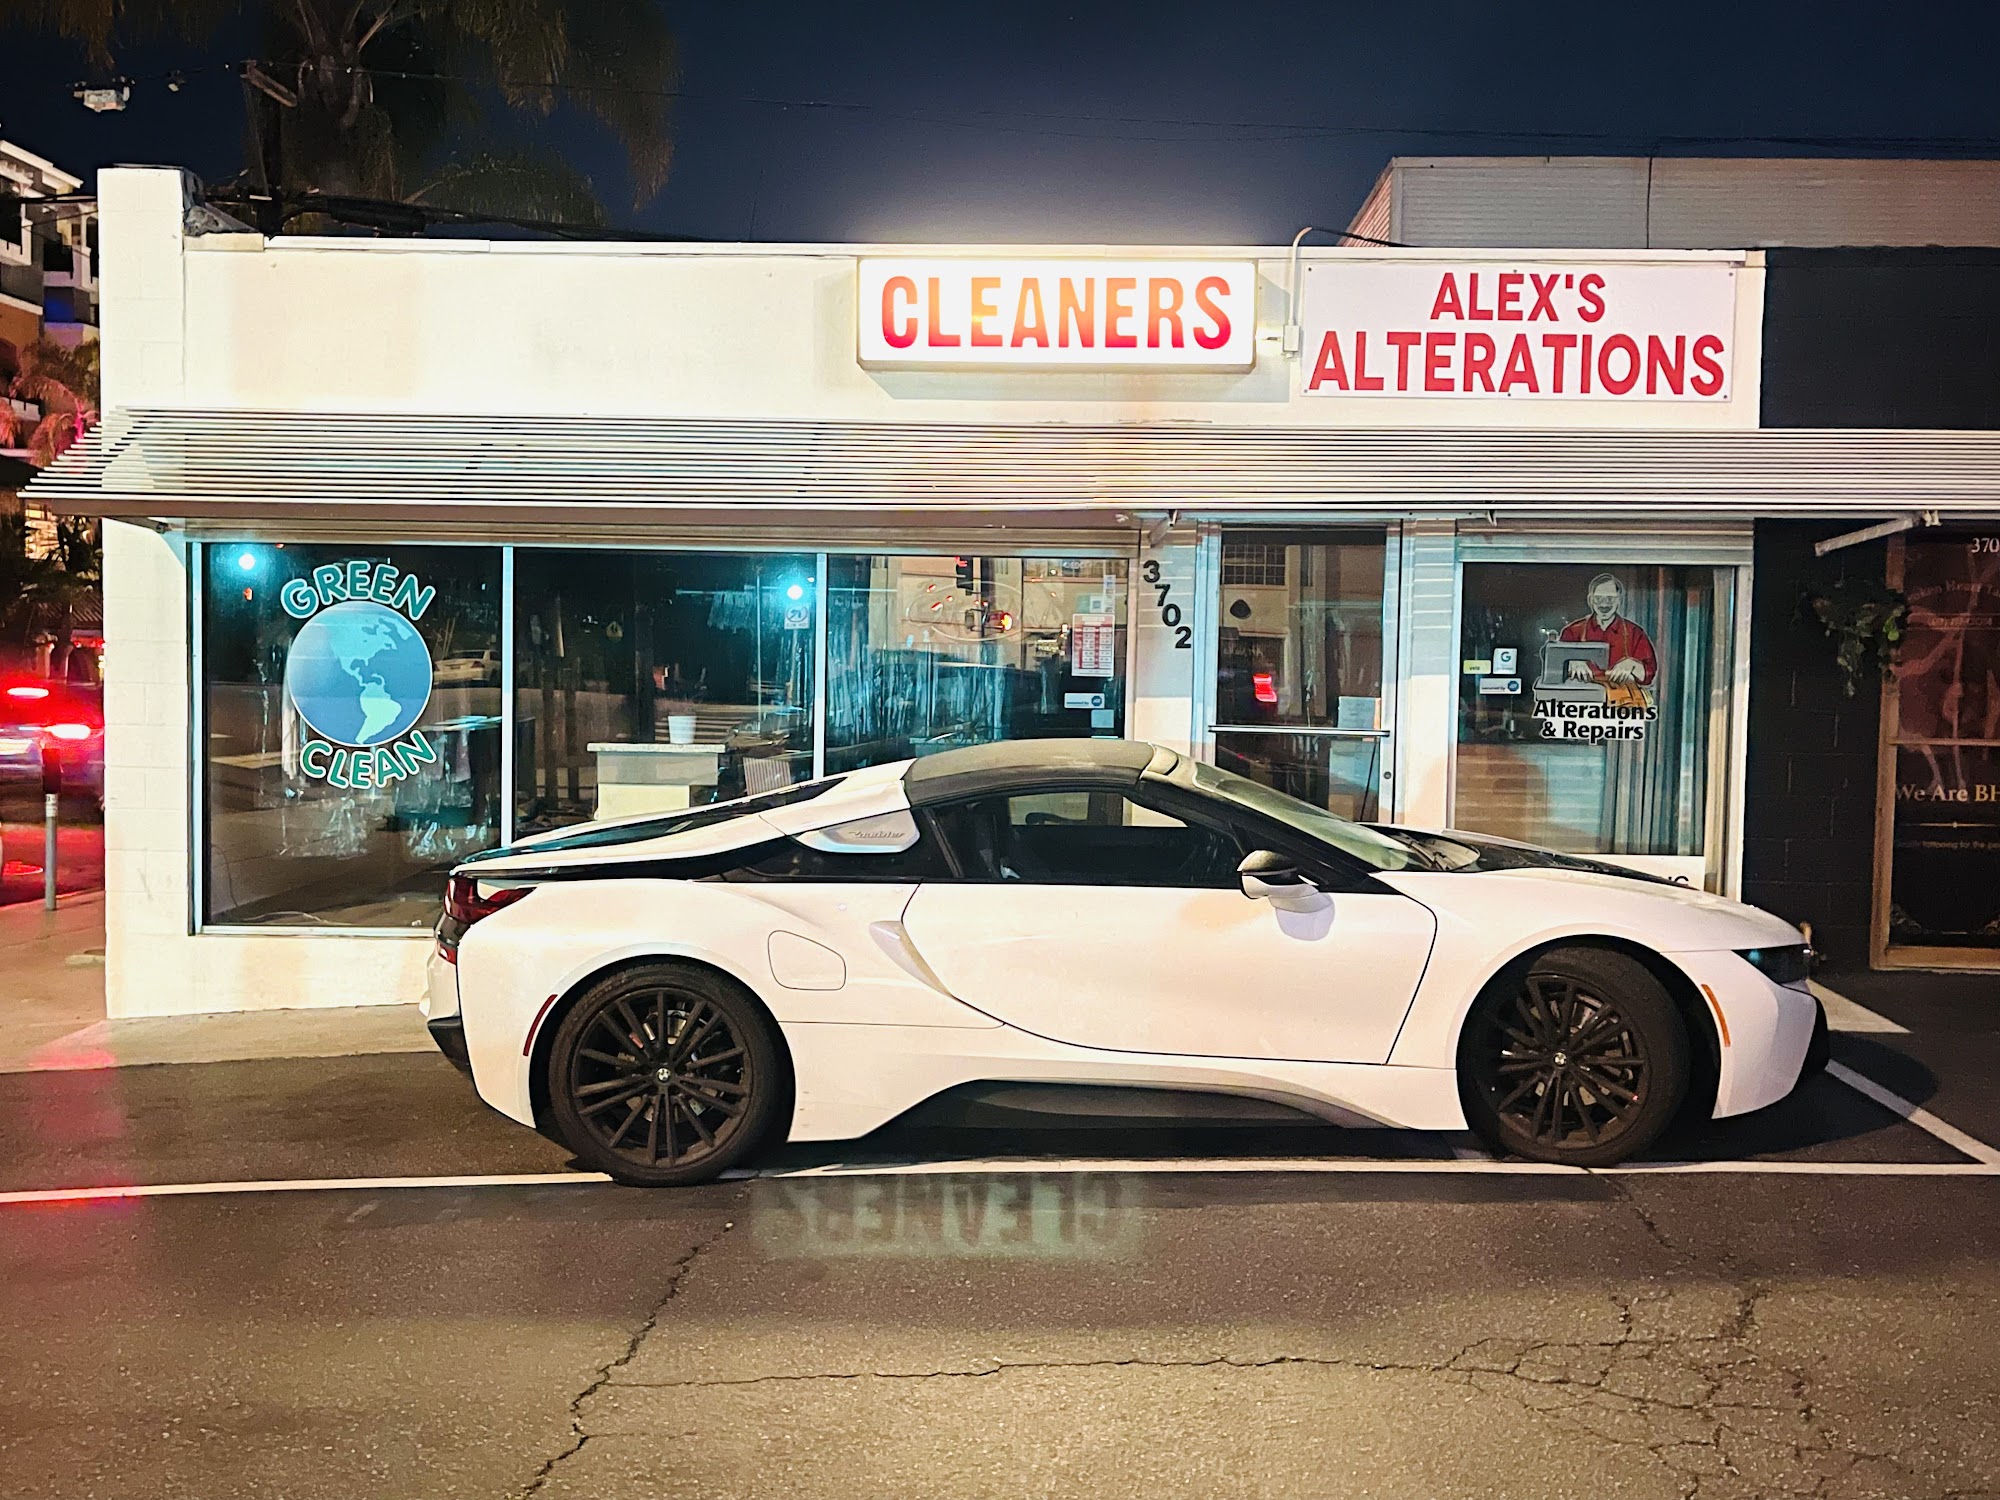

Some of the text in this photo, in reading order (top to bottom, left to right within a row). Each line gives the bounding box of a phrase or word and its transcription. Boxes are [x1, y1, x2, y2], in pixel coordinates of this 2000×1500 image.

[882, 276, 1231, 349] CLEANERS
[1430, 272, 1605, 323] ALEX'S
[1309, 331, 1725, 396] ALTERATIONS
[281, 560, 436, 621] GREEN
[1143, 560, 1192, 649] 3702
[1533, 698, 1657, 720] Alterations
[1542, 720, 1644, 744] & Repairs
[300, 729, 437, 789] CLEAN
[1931, 784, 1969, 802] Are
